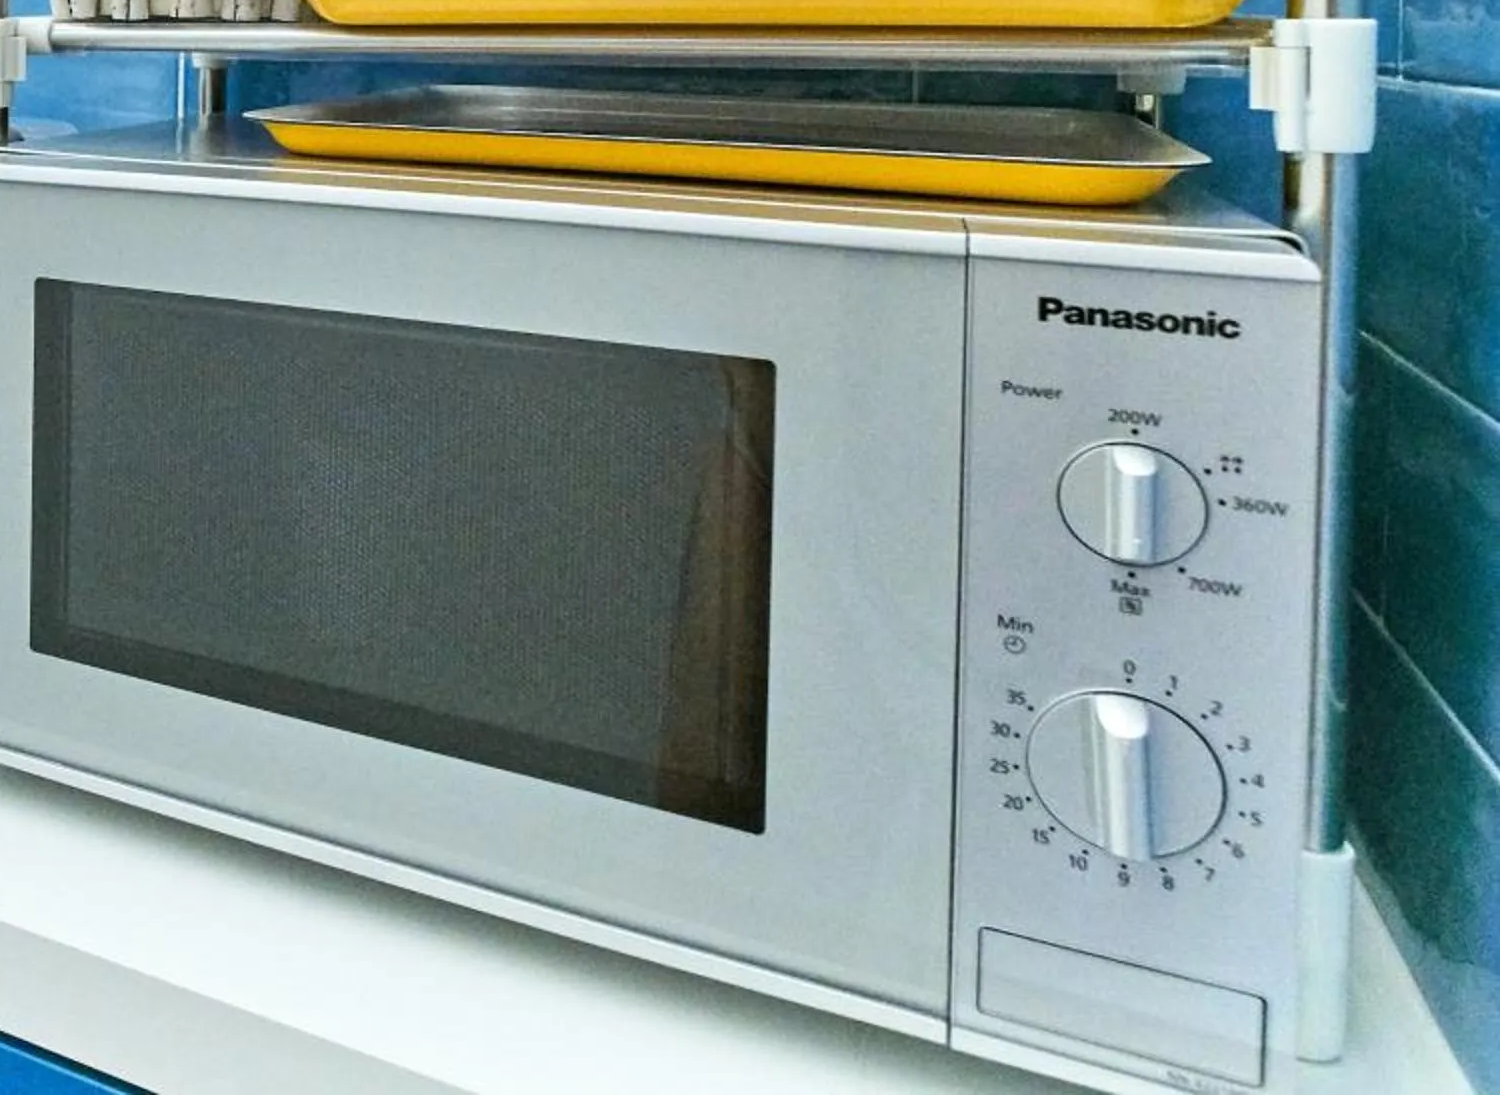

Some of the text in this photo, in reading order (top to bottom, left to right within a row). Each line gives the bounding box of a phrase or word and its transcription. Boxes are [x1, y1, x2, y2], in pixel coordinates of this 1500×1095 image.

[1037, 296, 1242, 340] Panasonic
[1001, 380, 1063, 401] Power
[1107, 408, 1163, 427] 200W
[1231, 496, 1289, 517] 360W
[1188, 577, 1243, 598] 700W
[998, 614, 1035, 634] Min
[1123, 660, 1136, 676] 0
[1169, 675, 1179, 690] 1
[1006, 688, 1027, 706] 35
[1210, 700, 1224, 717] 2
[990, 720, 1011, 738] 30
[1238, 736, 1251, 753] 3
[989, 758, 1011, 776] 25
[1250, 773, 1265, 788] 4
[1002, 794, 1025, 811] 20
[1250, 811, 1264, 827] 5
[1031, 828, 1050, 846] 15
[1231, 842, 1246, 859] 6
[1068, 854, 1089, 872] 10
[1116, 871, 1131, 888] 9
[1161, 874, 1176, 891] 8
[1203, 866, 1216, 882] 7
